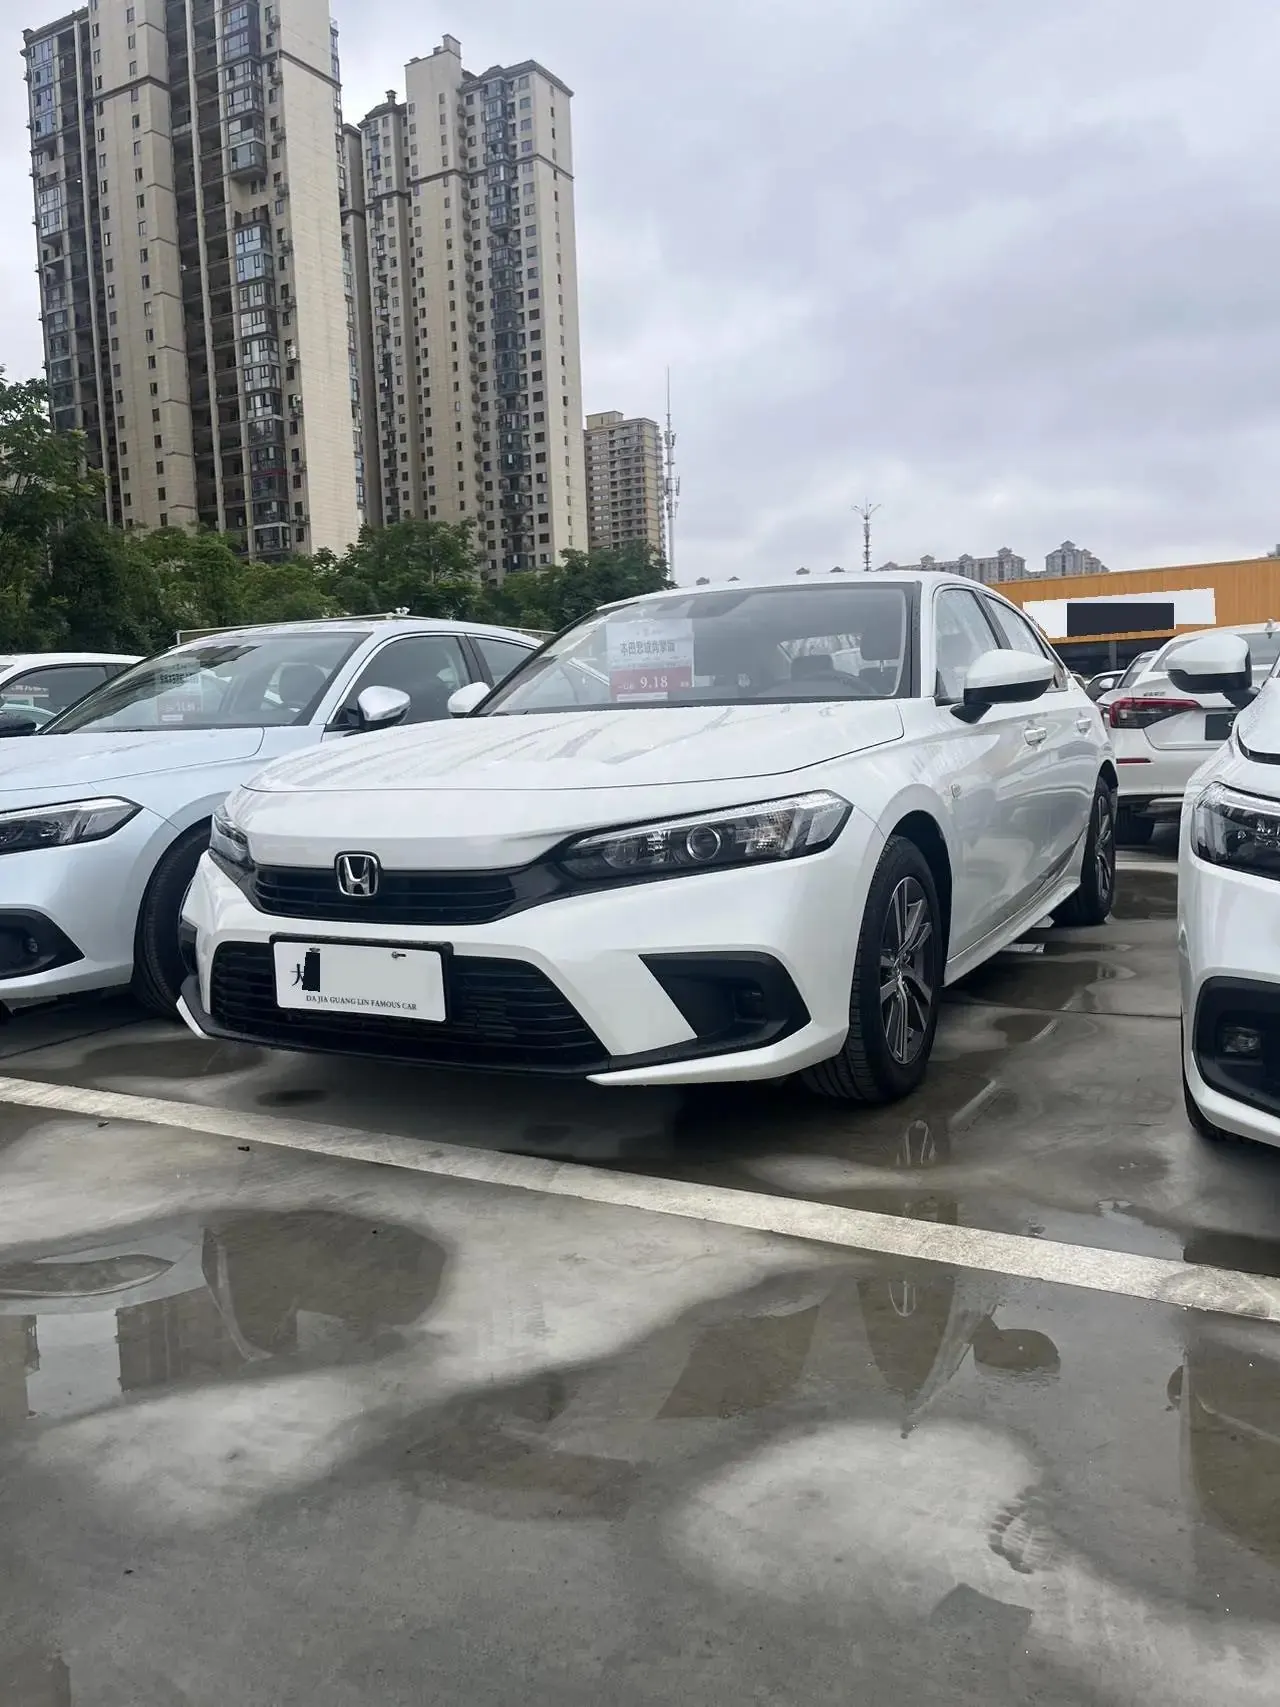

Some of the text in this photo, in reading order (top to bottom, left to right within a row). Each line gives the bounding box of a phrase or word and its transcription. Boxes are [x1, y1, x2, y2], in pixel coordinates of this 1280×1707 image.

[640, 676, 668, 689] 9.18
[306, 995, 417, 1011] DA JIA GUANG LIN FAMOUS CAR
